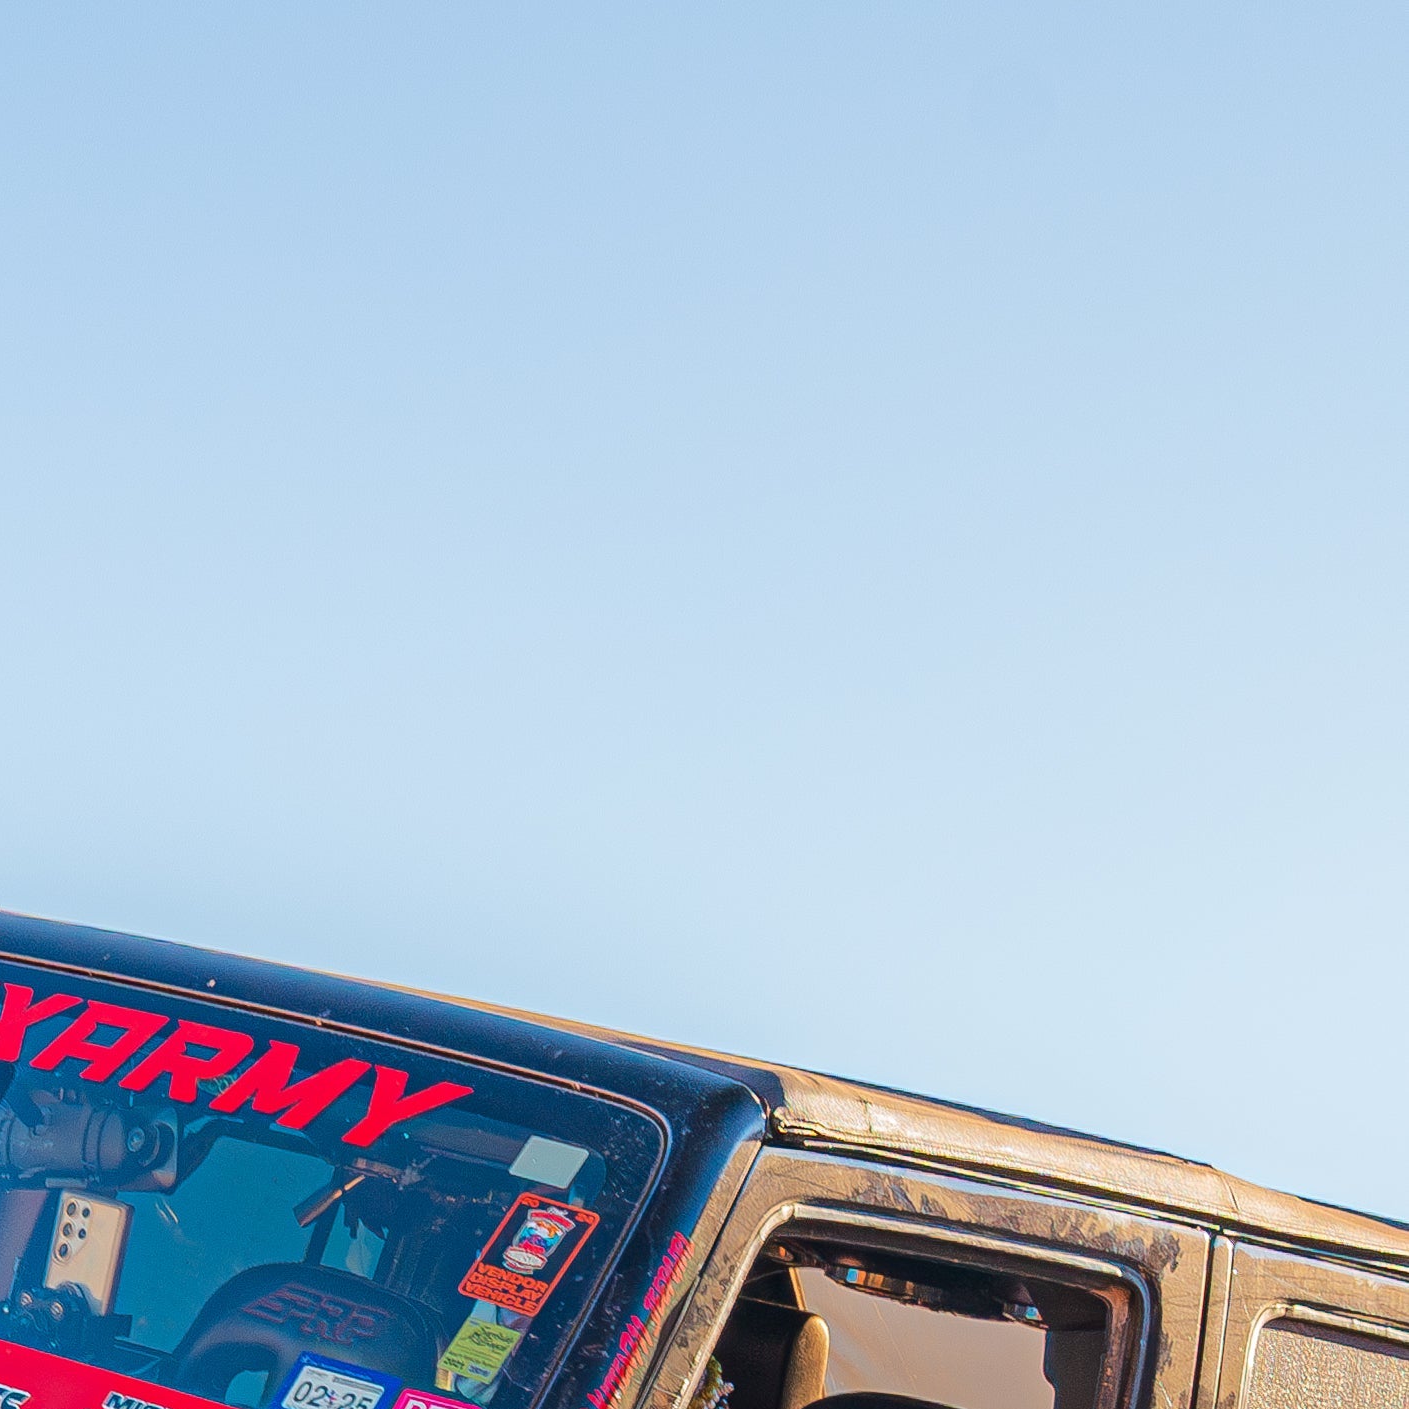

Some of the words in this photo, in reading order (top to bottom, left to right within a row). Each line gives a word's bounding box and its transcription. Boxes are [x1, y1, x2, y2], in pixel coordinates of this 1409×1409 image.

[468, 1272, 543, 1301] DISPLAY
[477, 1262, 550, 1292] VENDOR
[465, 1282, 540, 1311] VEHICLE
[293, 1380, 329, 1405] 02
